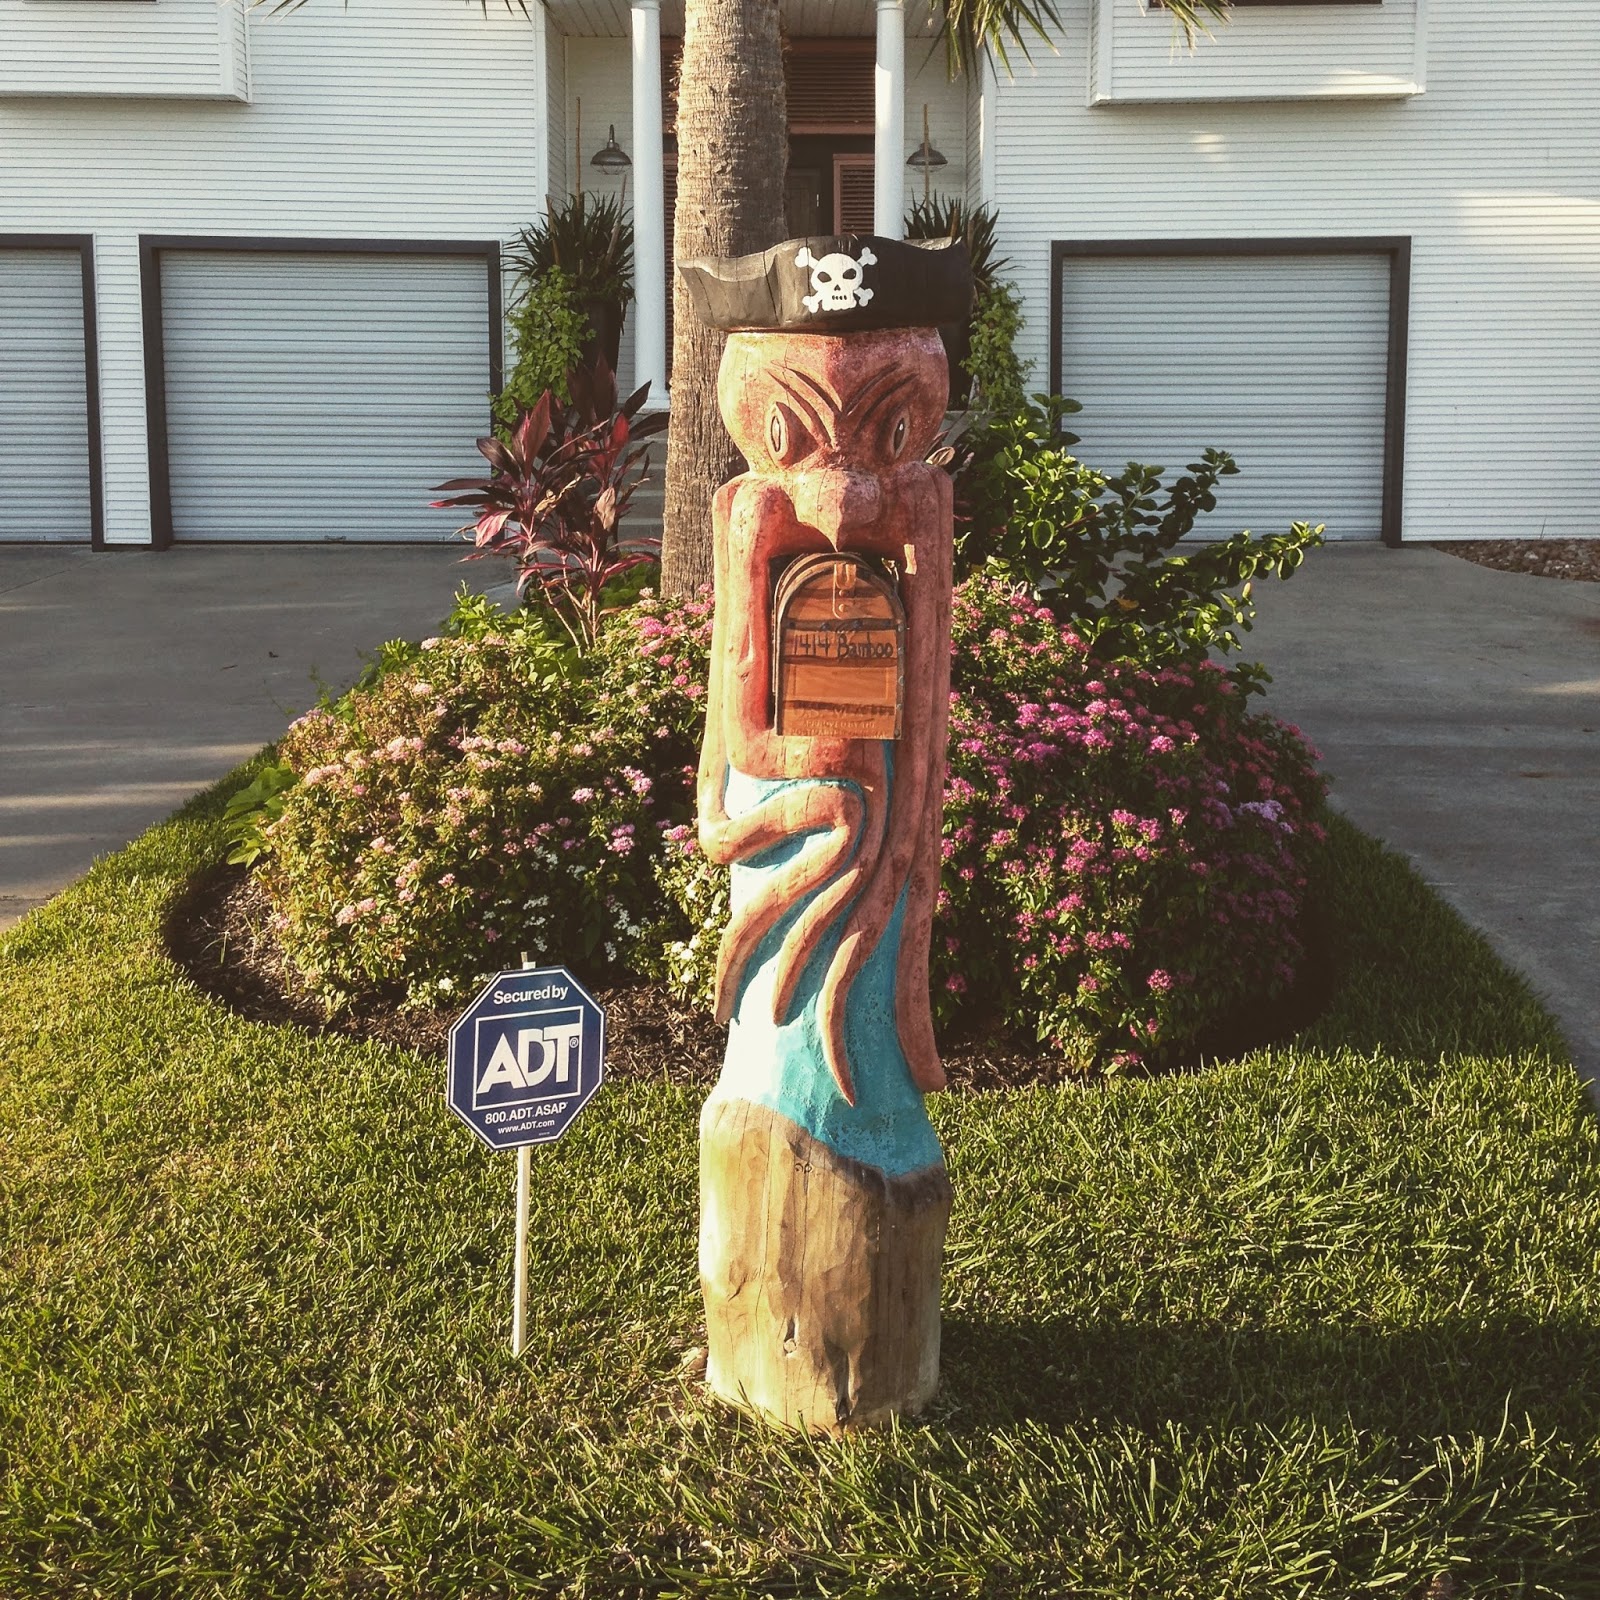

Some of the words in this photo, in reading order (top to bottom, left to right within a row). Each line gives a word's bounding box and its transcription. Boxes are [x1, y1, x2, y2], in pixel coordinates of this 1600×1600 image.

[837, 631, 894, 659] Bamboo
[493, 986, 550, 1005] Secured
[551, 984, 569, 1000] by
[476, 1022, 582, 1095] ADT
[484, 1101, 567, 1125] 800.ADT.ASAP
[497, 1119, 556, 1135] www.ADT.com
